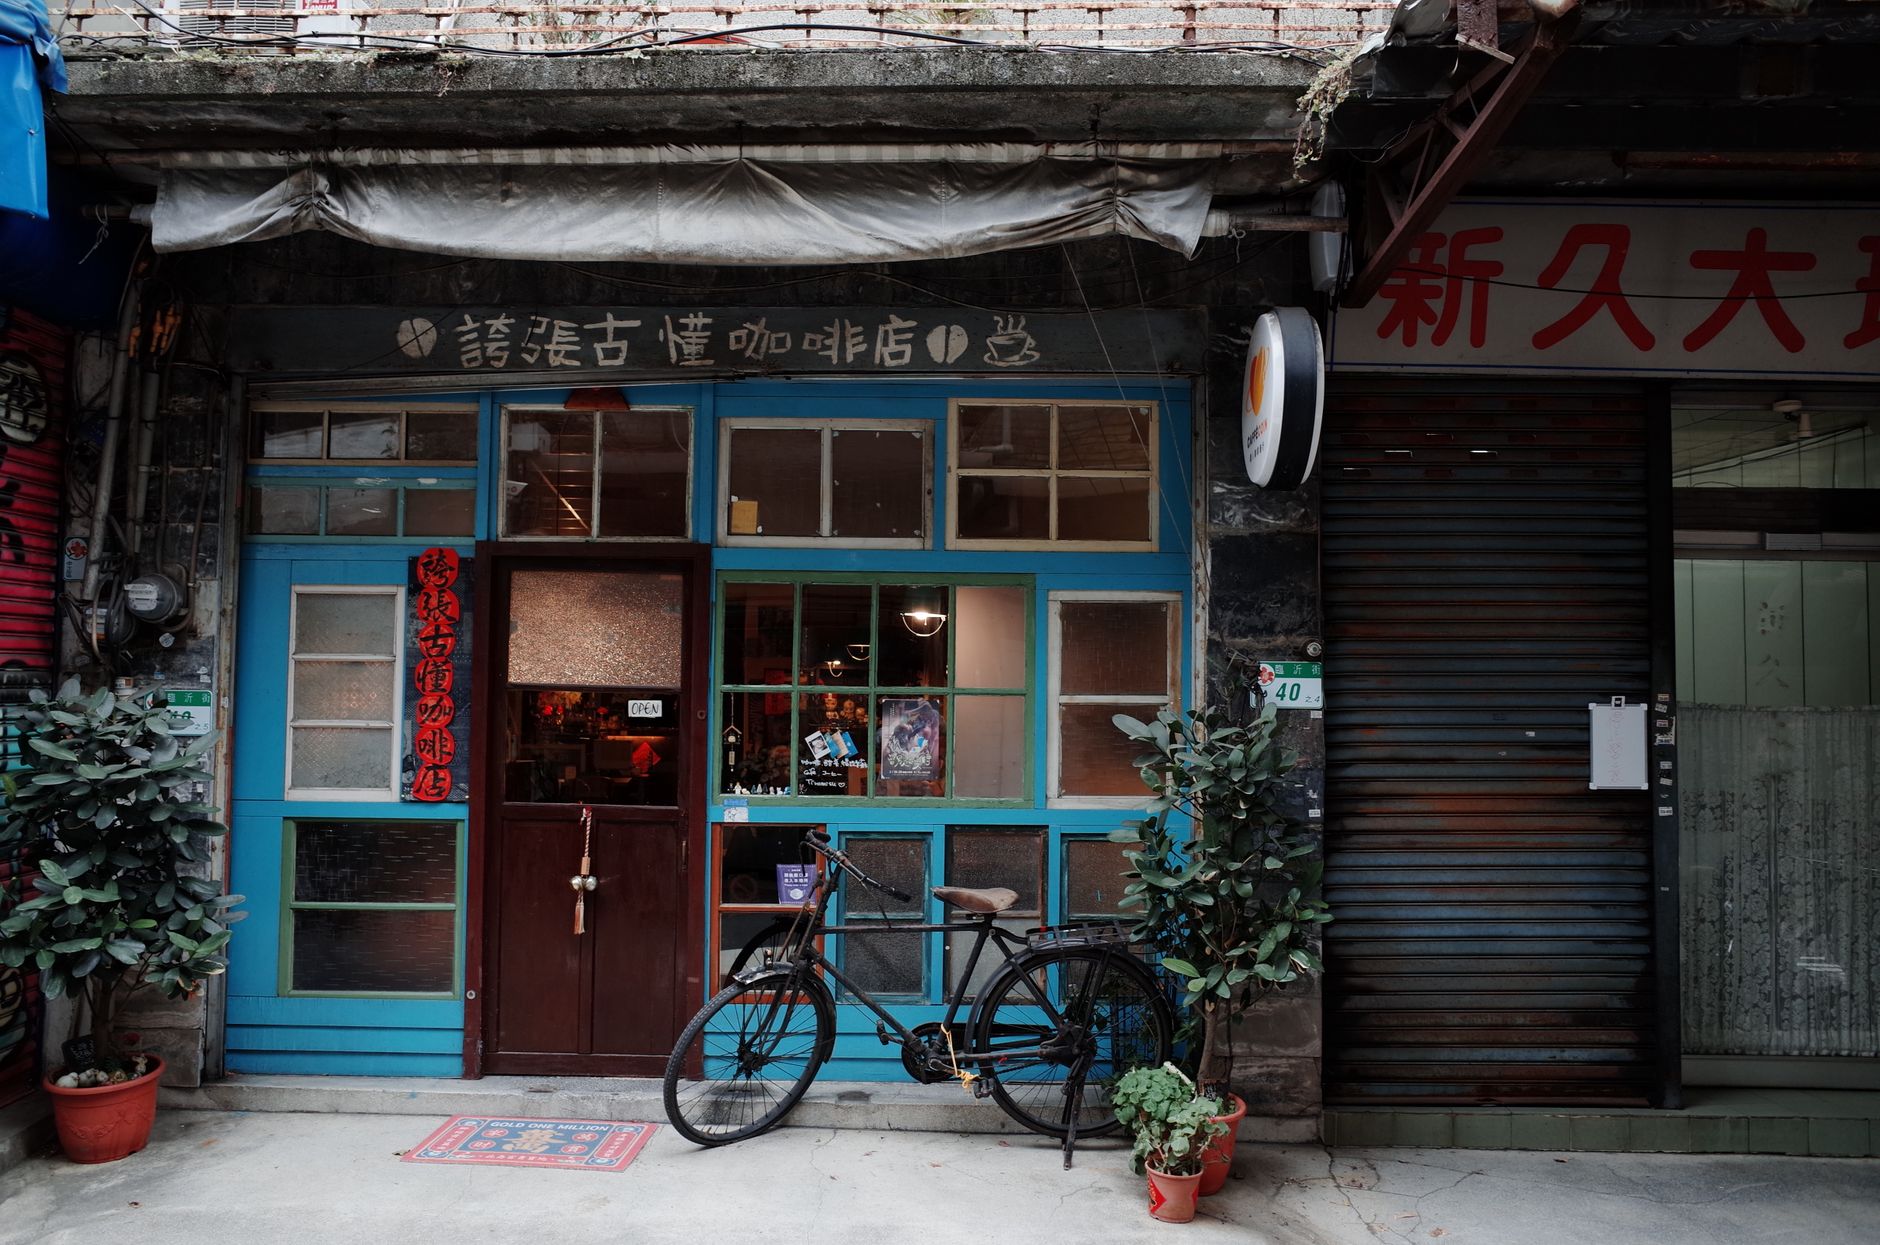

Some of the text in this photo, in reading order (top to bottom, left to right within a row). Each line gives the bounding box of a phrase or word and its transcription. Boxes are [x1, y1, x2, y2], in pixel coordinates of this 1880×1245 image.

[456, 312, 918, 368] 誇張古懂咖啡店
[415, 549, 455, 798] 誇張古懂咖啡店
[1276, 683, 1301, 701] 40
[631, 702, 659, 715] OPEN
